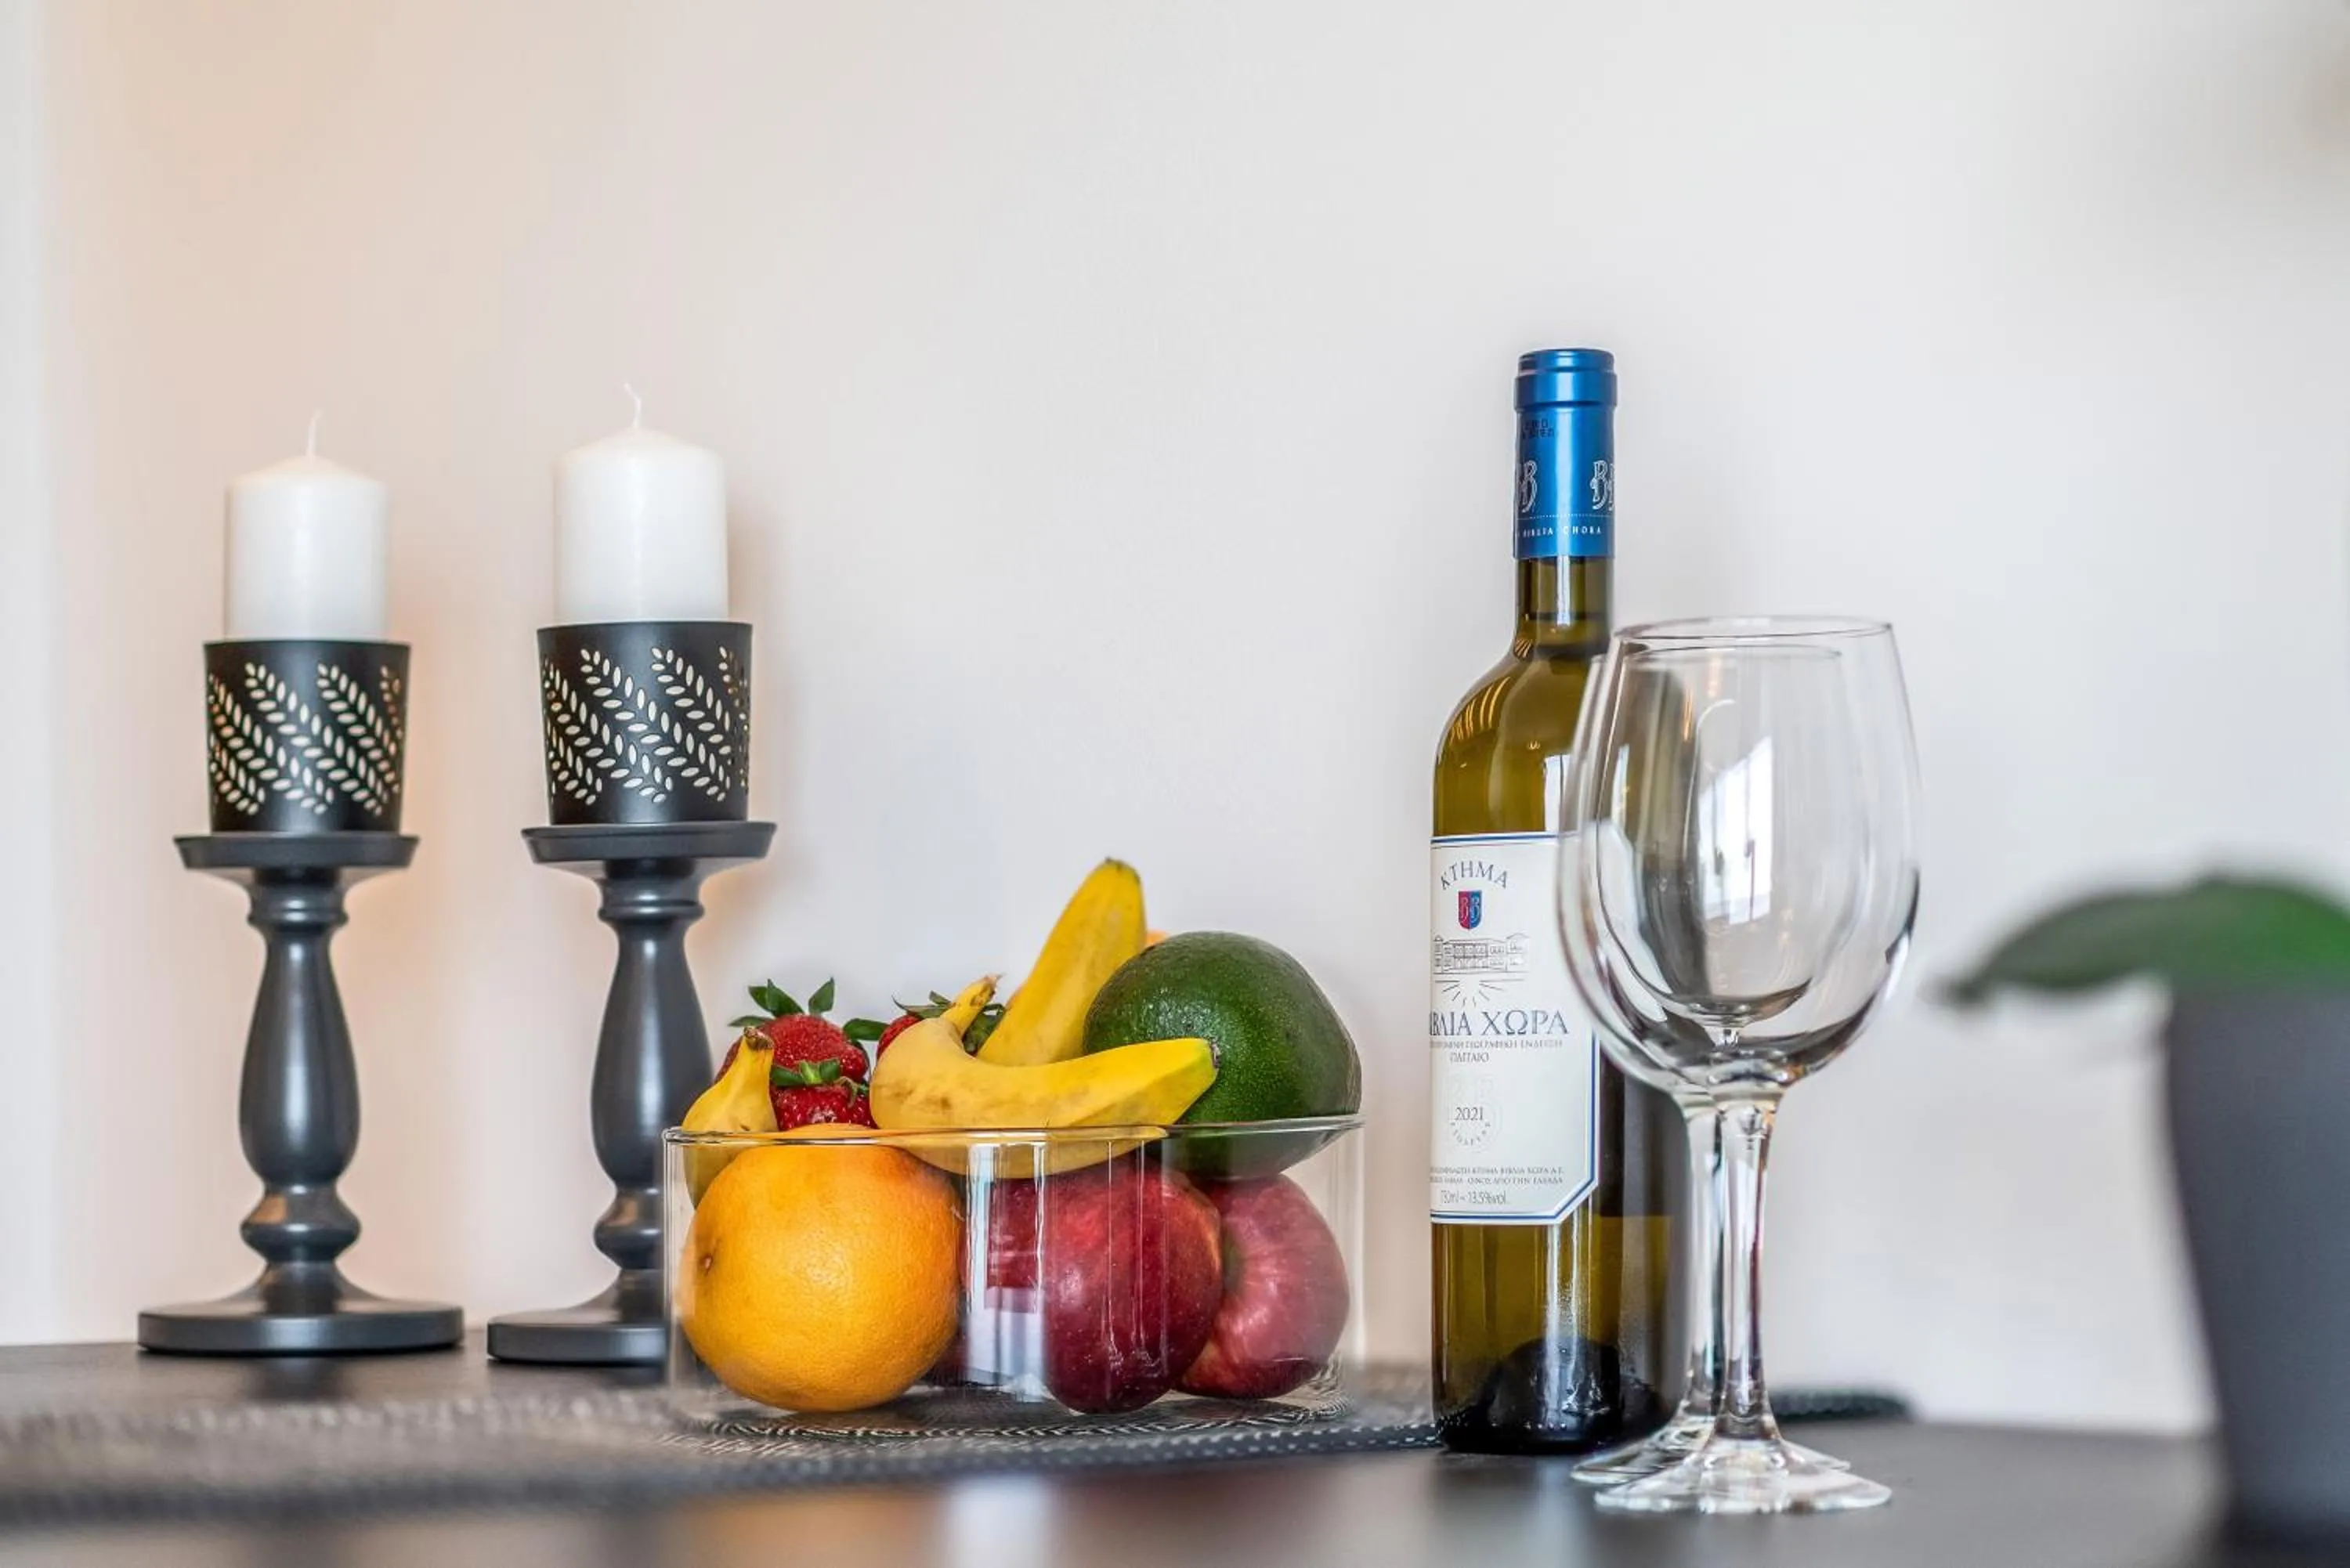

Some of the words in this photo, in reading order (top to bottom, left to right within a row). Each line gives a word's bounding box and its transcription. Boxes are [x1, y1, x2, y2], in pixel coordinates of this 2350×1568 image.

[1441, 860, 1508, 890] ΚΤΗΜΑ
[1480, 1009, 1570, 1035] ΧΩΡΑ
[1454, 1106, 1484, 1121] 2021
